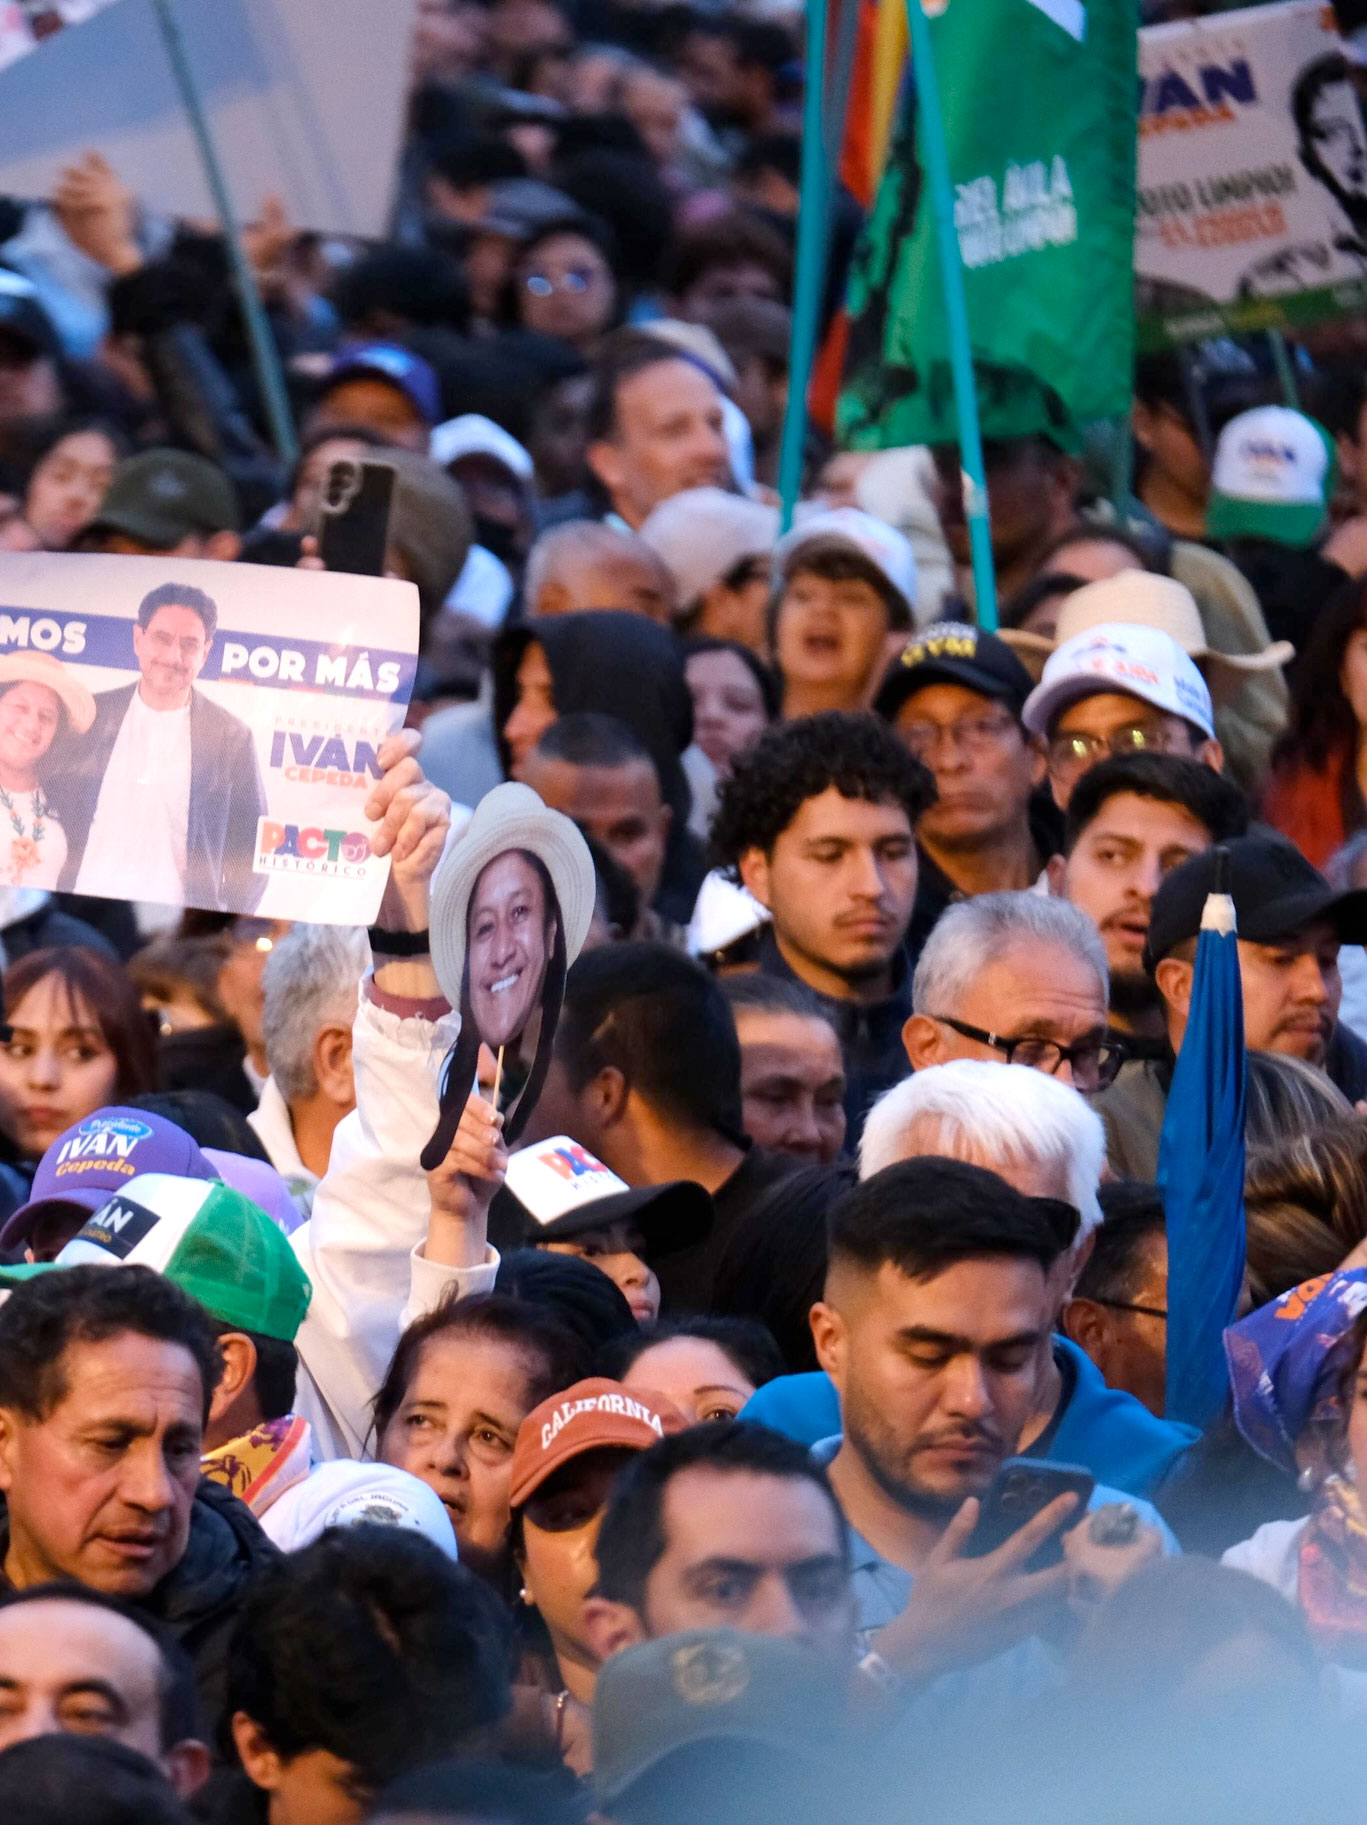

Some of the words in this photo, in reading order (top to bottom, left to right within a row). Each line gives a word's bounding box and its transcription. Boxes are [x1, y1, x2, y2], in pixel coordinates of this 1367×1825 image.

[221, 641, 307, 683] POR
[314, 651, 401, 693] MÁS
[273, 715, 381, 737] PRESIDENT
[269, 729, 386, 781] IVÁN
[284, 766, 368, 790] CEPEDA
[260, 820, 372, 865] PACTO
[55, 1156, 136, 1177] Cepeda
[536, 1144, 609, 1181] PAC
[541, 1392, 665, 1451] CALIFORNIA
